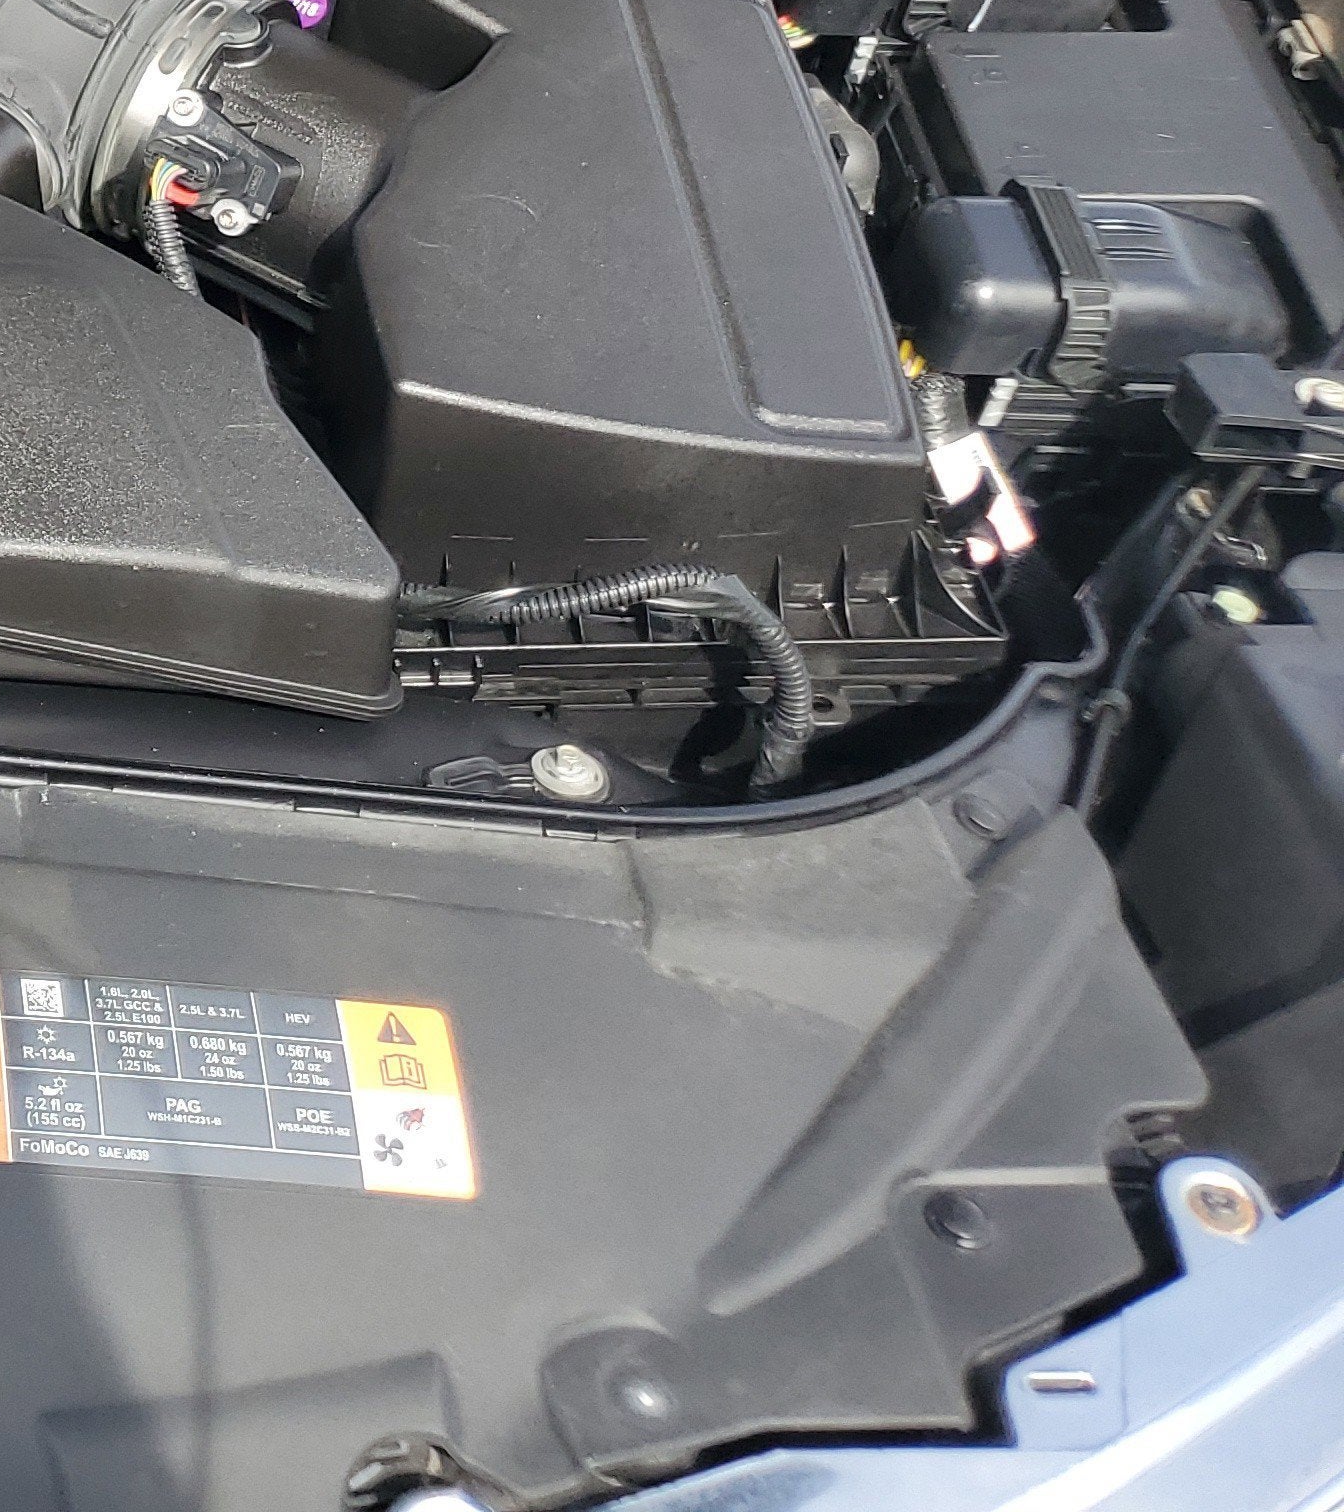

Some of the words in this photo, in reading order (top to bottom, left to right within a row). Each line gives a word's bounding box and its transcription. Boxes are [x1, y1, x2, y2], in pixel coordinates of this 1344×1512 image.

[95, 998, 122, 1010] 3.7L
[123, 1001, 151, 1012] GCC
[178, 1004, 206, 1016] 2.5L
[218, 1008, 246, 1019] 3.7L
[103, 1011, 130, 1022] 2.5L
[132, 1013, 162, 1025] E100
[284, 1012, 312, 1024] HEV
[107, 1029, 144, 1044] 0.567
[146, 1032, 165, 1050] kg
[189, 1035, 226, 1051] 0.680
[228, 1038, 247, 1056] kg
[21, 1045, 77, 1062] R-134a
[121, 1046, 136, 1058] 20
[138, 1049, 154, 1059] oz
[204, 1052, 220, 1064] 24
[221, 1055, 237, 1065] oz
[313, 1045, 333, 1063] kg
[117, 1060, 141, 1072] 1.25
[143, 1061, 163, 1073] lbs
[200, 1065, 224, 1078] 1.50
[226, 1068, 246, 1080] lbs
[290, 1059, 305, 1071] 20
[307, 1062, 322, 1072] oz
[286, 1072, 310, 1085] 1.25
[312, 1074, 331, 1086] lbs
[24, 1096, 47, 1111] 5.2
[50, 1098, 62, 1112] fl
[64, 1102, 85, 1113] oz
[165, 1097, 202, 1114] PAG
[26, 1111, 60, 1128] (155
[62, 1114, 87, 1131] cc)
[294, 1108, 335, 1125] POE
[18, 1138, 90, 1157] FoMoCo
[98, 1145, 123, 1159] SAE
